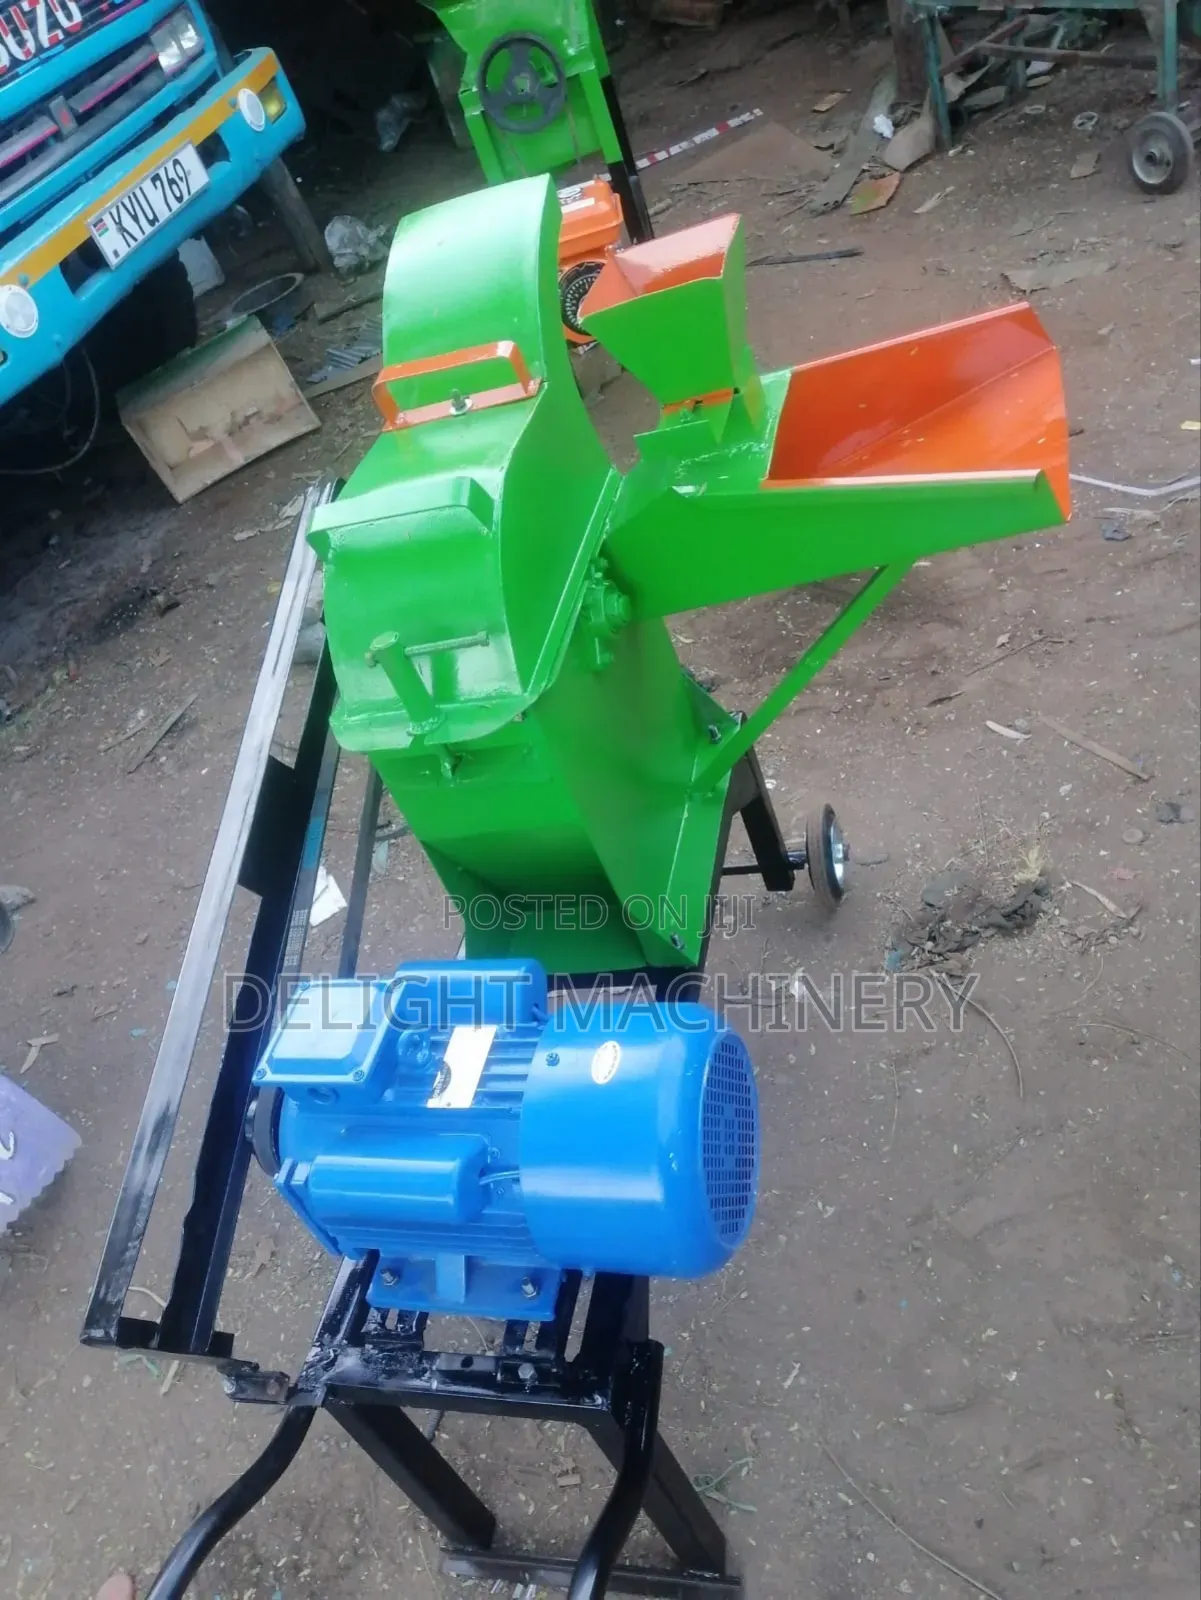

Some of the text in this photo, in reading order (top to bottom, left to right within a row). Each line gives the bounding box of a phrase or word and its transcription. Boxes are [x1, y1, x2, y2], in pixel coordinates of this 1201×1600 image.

[0, 0, 83, 75] UZU
[109, 158, 191, 248] KYU 769
